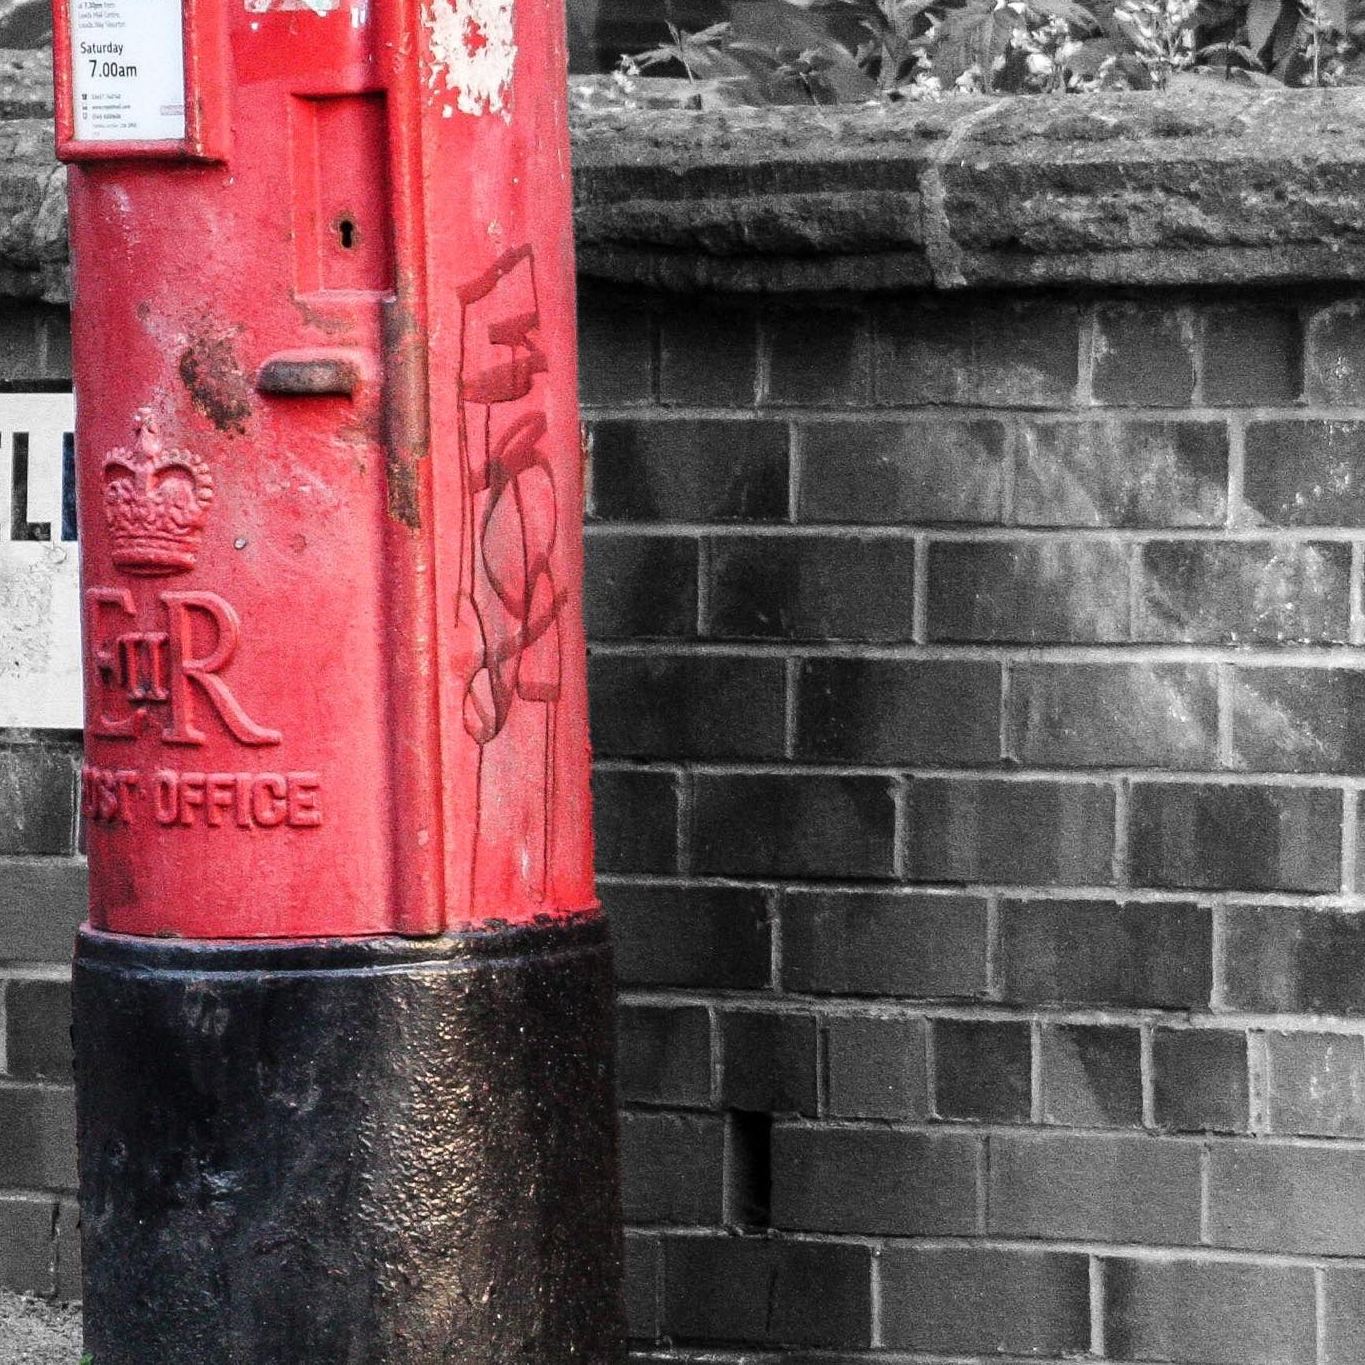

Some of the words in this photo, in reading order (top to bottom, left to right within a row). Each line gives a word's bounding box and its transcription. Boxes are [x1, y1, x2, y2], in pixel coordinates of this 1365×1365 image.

[80, 41, 124, 55] Saturday
[88, 59, 138, 78] 7.00am
[157, 768, 322, 829] OFFICE
